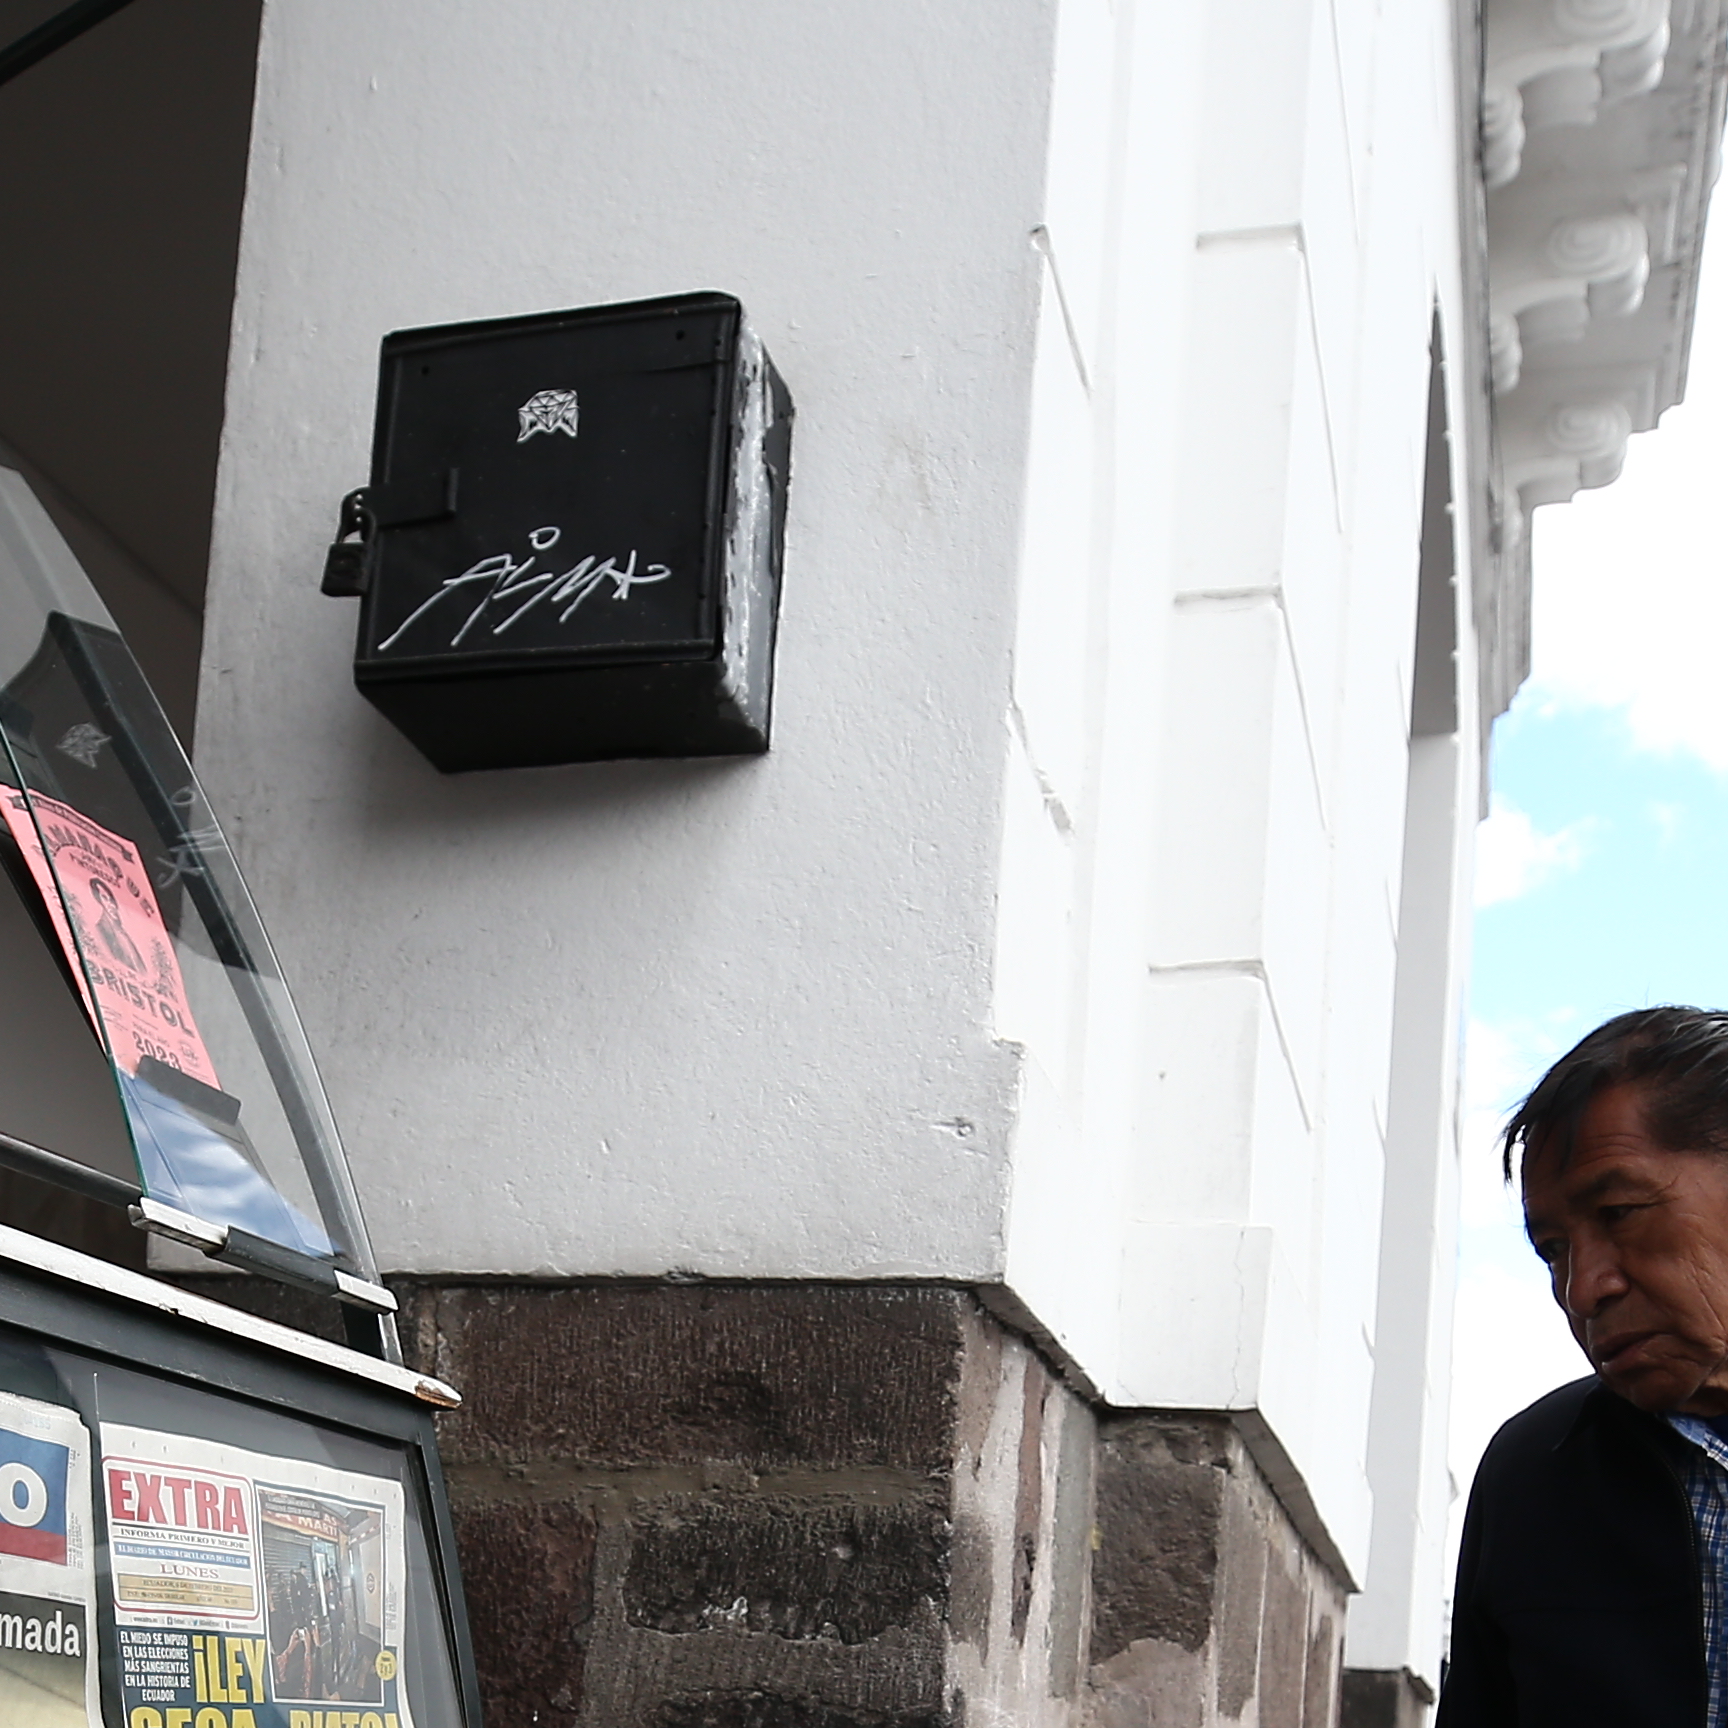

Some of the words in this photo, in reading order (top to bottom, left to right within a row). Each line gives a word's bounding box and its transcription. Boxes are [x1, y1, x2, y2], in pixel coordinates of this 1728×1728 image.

[85, 958, 196, 1038] BRISTOL
[108, 1468, 250, 1536] EXTRA
[120, 1527, 167, 1541] INFORMA
[168, 1533, 210, 1545] PRIMERO
[217, 1540, 245, 1550] MEJOR
[160, 1564, 220, 1579] LUNES
[120, 1630, 129, 1643] EL
[130, 1632, 151, 1645] MIEDO
[153, 1632, 163, 1645] SE
[164, 1634, 189, 1646] IMPUSO
[123, 1646, 133, 1659] EN
[134, 1646, 148, 1659] LAS
[148, 1647, 189, 1660] ELECCIONES
[124, 1657, 140, 1672] MÁS
[140, 1661, 190, 1675] SANGRIENTAS
[192, 1635, 267, 1704] ¡LEY
[125, 1674, 136, 1687] EN
[136, 1674, 147, 1687] LA
[147, 1675, 179, 1688] HISTORIA
[180, 1676, 191, 1688] DE
[142, 1689, 175, 1702] ECUADOR
